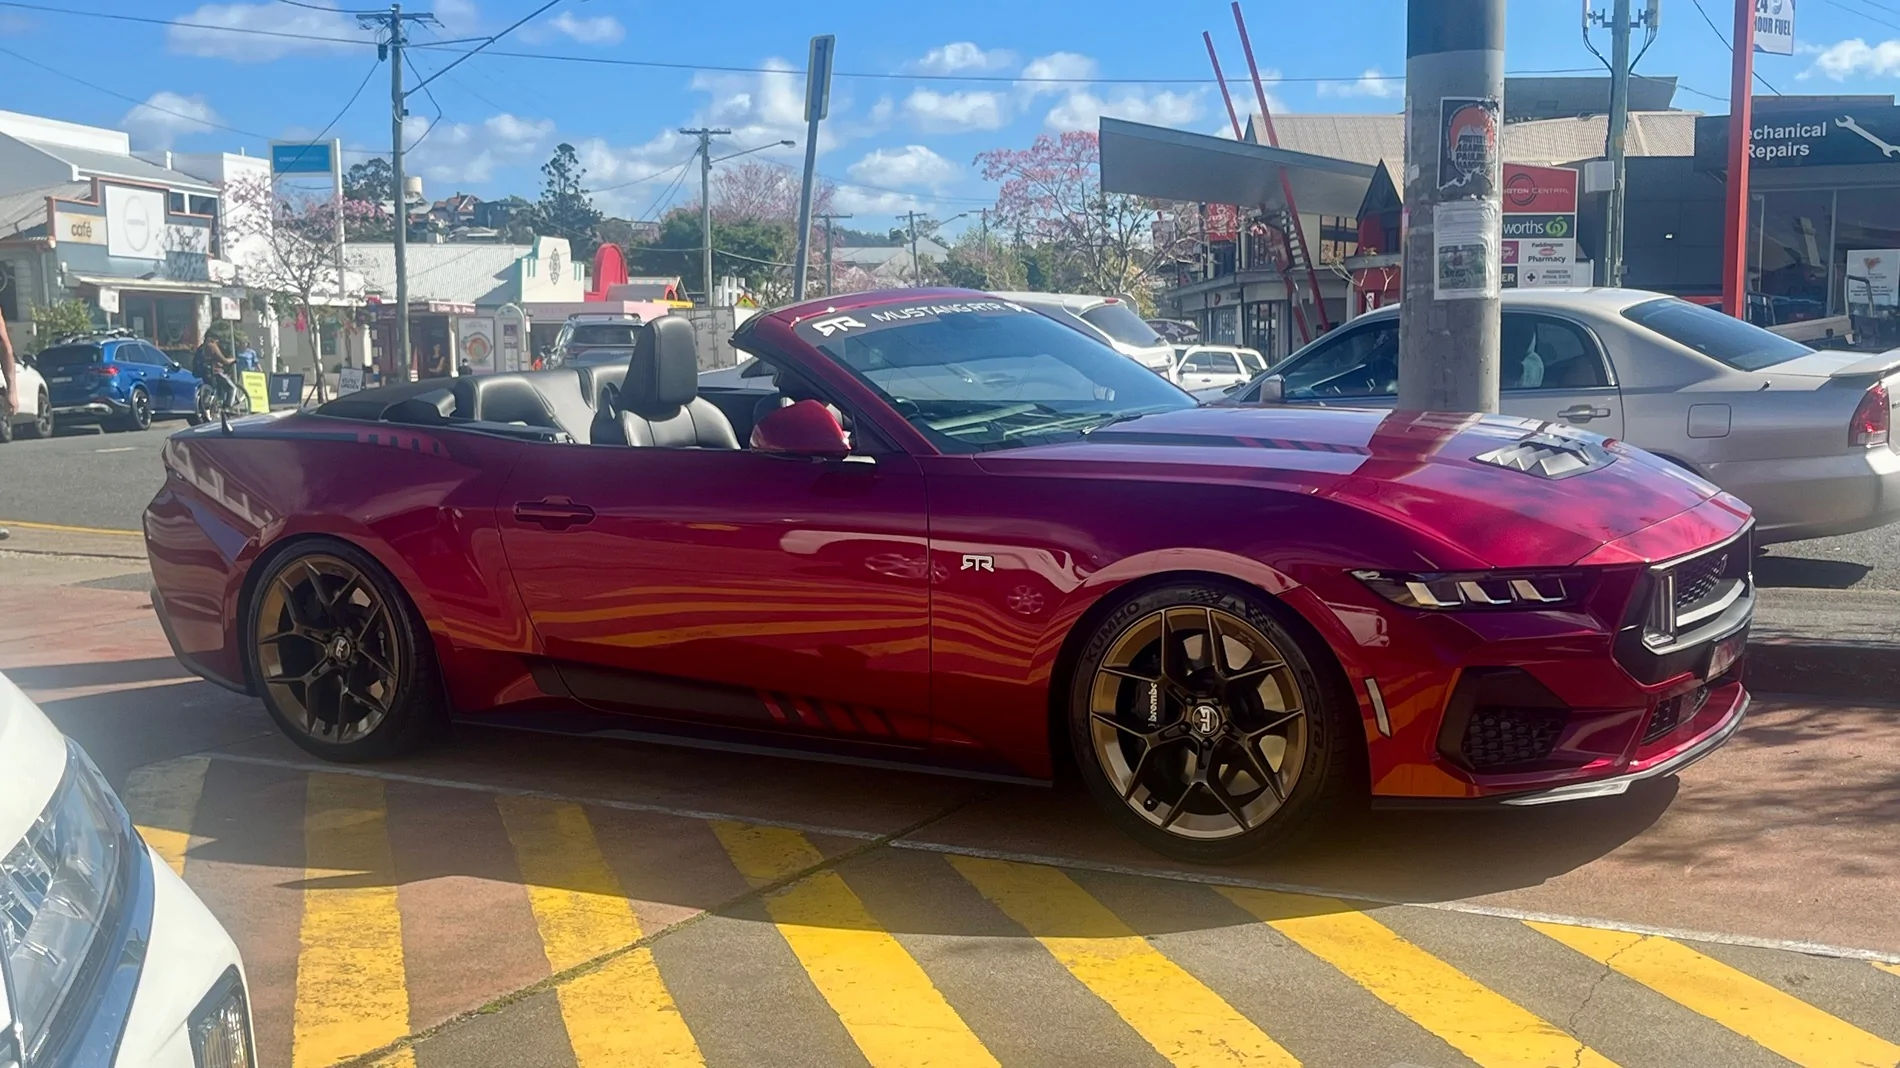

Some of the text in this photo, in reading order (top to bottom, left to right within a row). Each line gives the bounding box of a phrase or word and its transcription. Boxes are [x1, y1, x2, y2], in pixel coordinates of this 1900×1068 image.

[1774, 18, 1791, 36] FUEL
[1748, 141, 1810, 161] Repairs
[71, 220, 92, 238] café
[1503, 220, 1544, 236] worths
[1527, 255, 1567, 263] Pharmacy
[870, 303, 972, 323] MUSTANG
[1084, 601, 1140, 664] KUMHO
